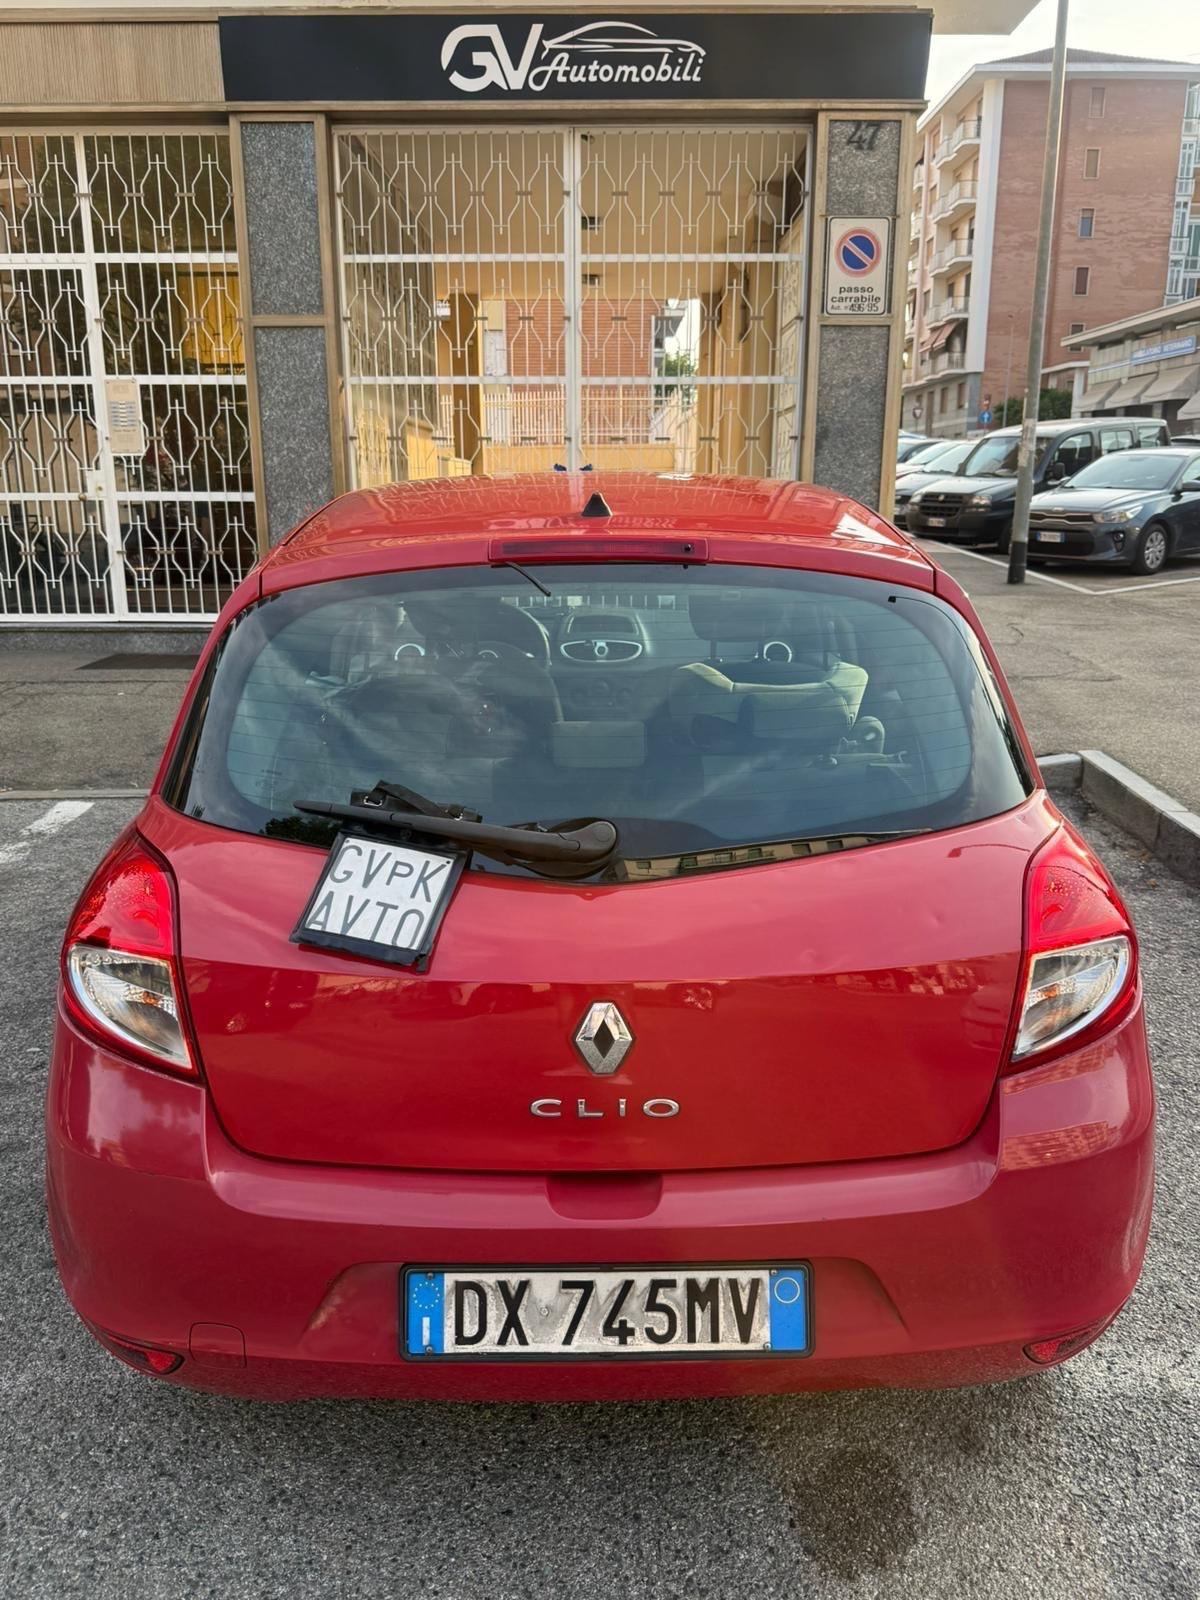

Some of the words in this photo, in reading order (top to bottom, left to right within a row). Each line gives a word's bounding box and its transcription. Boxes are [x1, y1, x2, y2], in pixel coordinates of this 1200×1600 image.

[441, 24, 544, 92] GV
[528, 52, 704, 92] Automobili
[830, 295, 881, 304] carrabile
[839, 286, 874, 295] passo
[530, 1098, 680, 1117] CLIO
[454, 1279, 530, 1346] DX
[560, 1278, 761, 1346] 745MV
